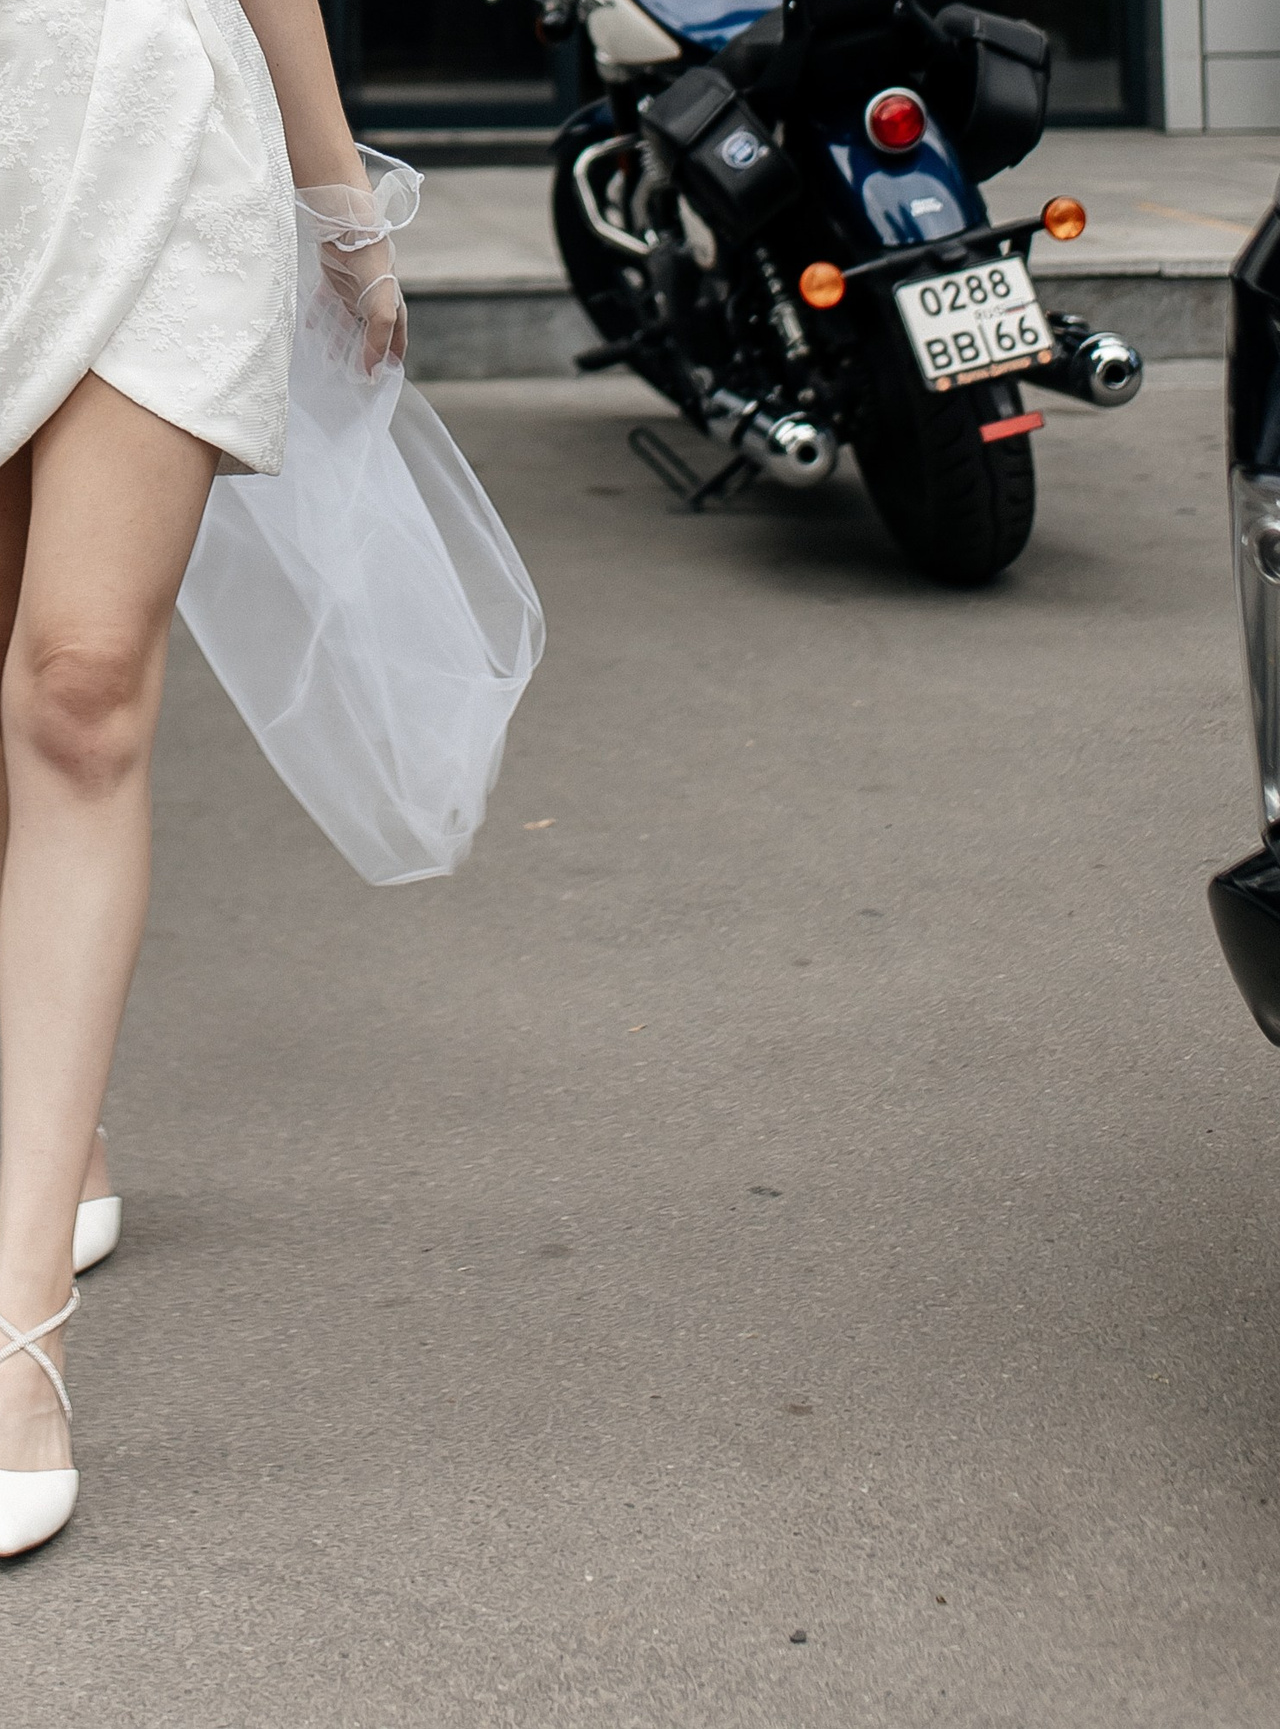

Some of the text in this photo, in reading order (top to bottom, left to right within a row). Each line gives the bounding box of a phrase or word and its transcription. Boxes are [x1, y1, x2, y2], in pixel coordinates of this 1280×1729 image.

[920, 268, 1011, 317] 0288
[925, 314, 1039, 370] ВВ 66
